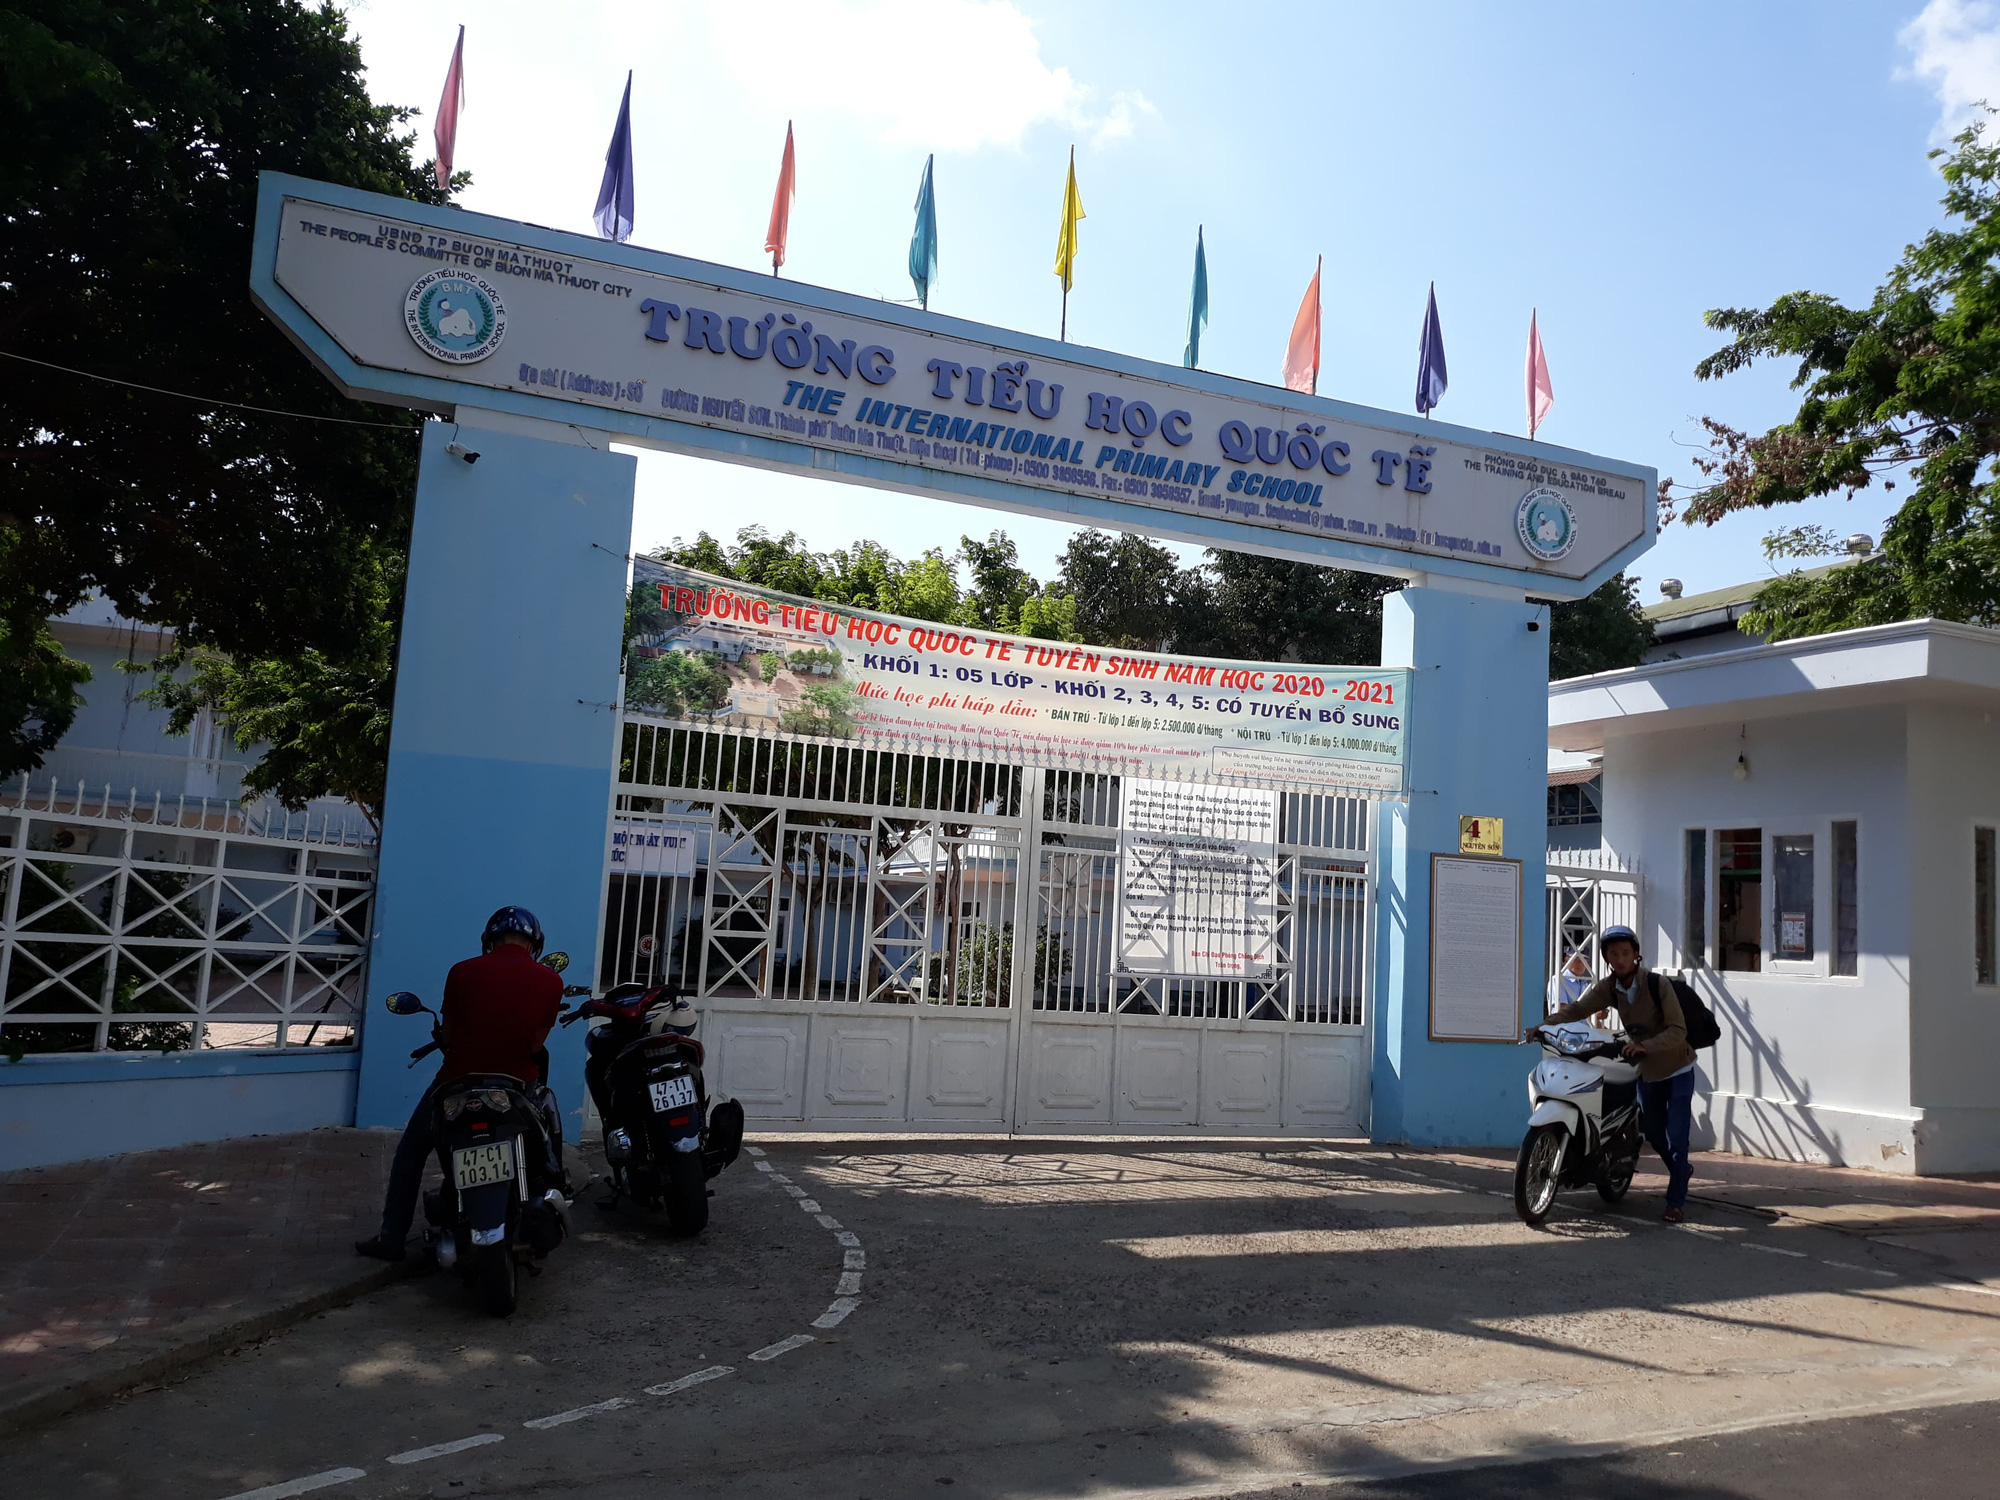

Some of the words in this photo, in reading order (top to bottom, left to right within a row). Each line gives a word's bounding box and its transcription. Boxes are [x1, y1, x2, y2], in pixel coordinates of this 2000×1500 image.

[379, 225, 422, 243] UBND
[428, 236, 448, 248] TP
[498, 250, 520, 264] MA
[300, 220, 327, 236] THE
[330, 227, 396, 250] PEOPLE'S
[399, 242, 469, 266] COMMITTE
[474, 257, 492, 270] OF
[495, 261, 532, 278] BUON
[534, 269, 554, 283] MA
[557, 274, 600, 292] THUOT
[603, 283, 632, 298] CITY
[442, 282, 473, 295] BMT
[457, 271, 478, 283] HỌC
[407, 309, 416, 324] THE
[411, 323, 460, 360] INTERNATIONAL
[488, 321, 505, 348] SCHOOL
[460, 344, 490, 360] PRIMARY
[640, 297, 897, 385] TRƯỜNG
[927, 357, 1064, 420] TIỂU
[1085, 391, 1194, 448] HỌC
[1219, 419, 1351, 477] QUỐC
[1372, 445, 1437, 495] TẾ
[782, 381, 846, 415] THE
[856, 396, 1085, 464] INTERNATIONAL
[1095, 445, 1221, 488] PRIMARY
[1227, 469, 1324, 507] SCHOOL
[1464, 460, 1481, 472] THE
[1484, 464, 1524, 480] TRAINING
[1526, 473, 1545, 484] AND
[1548, 478, 1596, 494] EDUCATION
[1598, 487, 1626, 500] BREAU
[1484, 454, 1515, 468] PHÒNG
[1518, 461, 1538, 473] GIÁO
[1561, 471, 1567, 480] &
[656, 583, 769, 626] TRƯỜNG
[847, 616, 902, 648] HỌC
[1104, 655, 1160, 680] SINH
[1220, 668, 1264, 694] HỌC
[1272, 673, 1325, 698] 2020
[1344, 680, 1395, 705] 2021
[850, 680, 890, 700] Mức
[894, 686, 924, 708] học
[928, 692, 958, 710] phí
[962, 695, 995, 716] hấp
[1000, 698, 1038, 718] dẫn:
[863, 653, 920, 675] KHỐI
[929, 663, 949, 679] 1:
[956, 667, 984, 684] 05
[991, 670, 1034, 690] LỚP
[1055, 680, 1106, 699] KHỐI
[1113, 687, 1133, 704] 2,
[1140, 690, 1159, 708] 3,
[1166, 693, 1184, 710] 4,
[1192, 696, 1210, 710] 5:
[1216, 697, 1242, 714] CÓ
[1250, 700, 1312, 722] TUYỂN
[1319, 704, 1346, 724] BỔ
[1352, 712, 1400, 730] SUNG
[1050, 707, 1070, 722] BÁN
[1073, 710, 1090, 724] TRÚ
[1098, 712, 1108, 724] Từ
[1108, 713, 1120, 727] lớp
[1121, 715, 1125, 726] 1
[1127, 716, 1140, 728] đến
[1140, 717, 1152, 731] lớp
[1153, 718, 1160, 730] 5:
[1161, 719, 1196, 734] 2.500.000
[1237, 729, 1252, 742] NỘI
[1254, 728, 1272, 742] TRÚ
[1292, 732, 1302, 746] lớp
[1304, 735, 1308, 744] 1
[1309, 734, 1321, 746] đến
[1322, 735, 1332, 749] lớp
[1333, 736, 1340, 748] 5:
[1340, 738, 1372, 752] 4.000.000
[1465, 820, 1481, 838] 4
[654, 1090, 692, 1110] 261.37
[656, 1078, 686, 1096] 47-T1
[463, 1146, 502, 1166] 47-C1
[459, 1162, 510, 1186] 103.14
